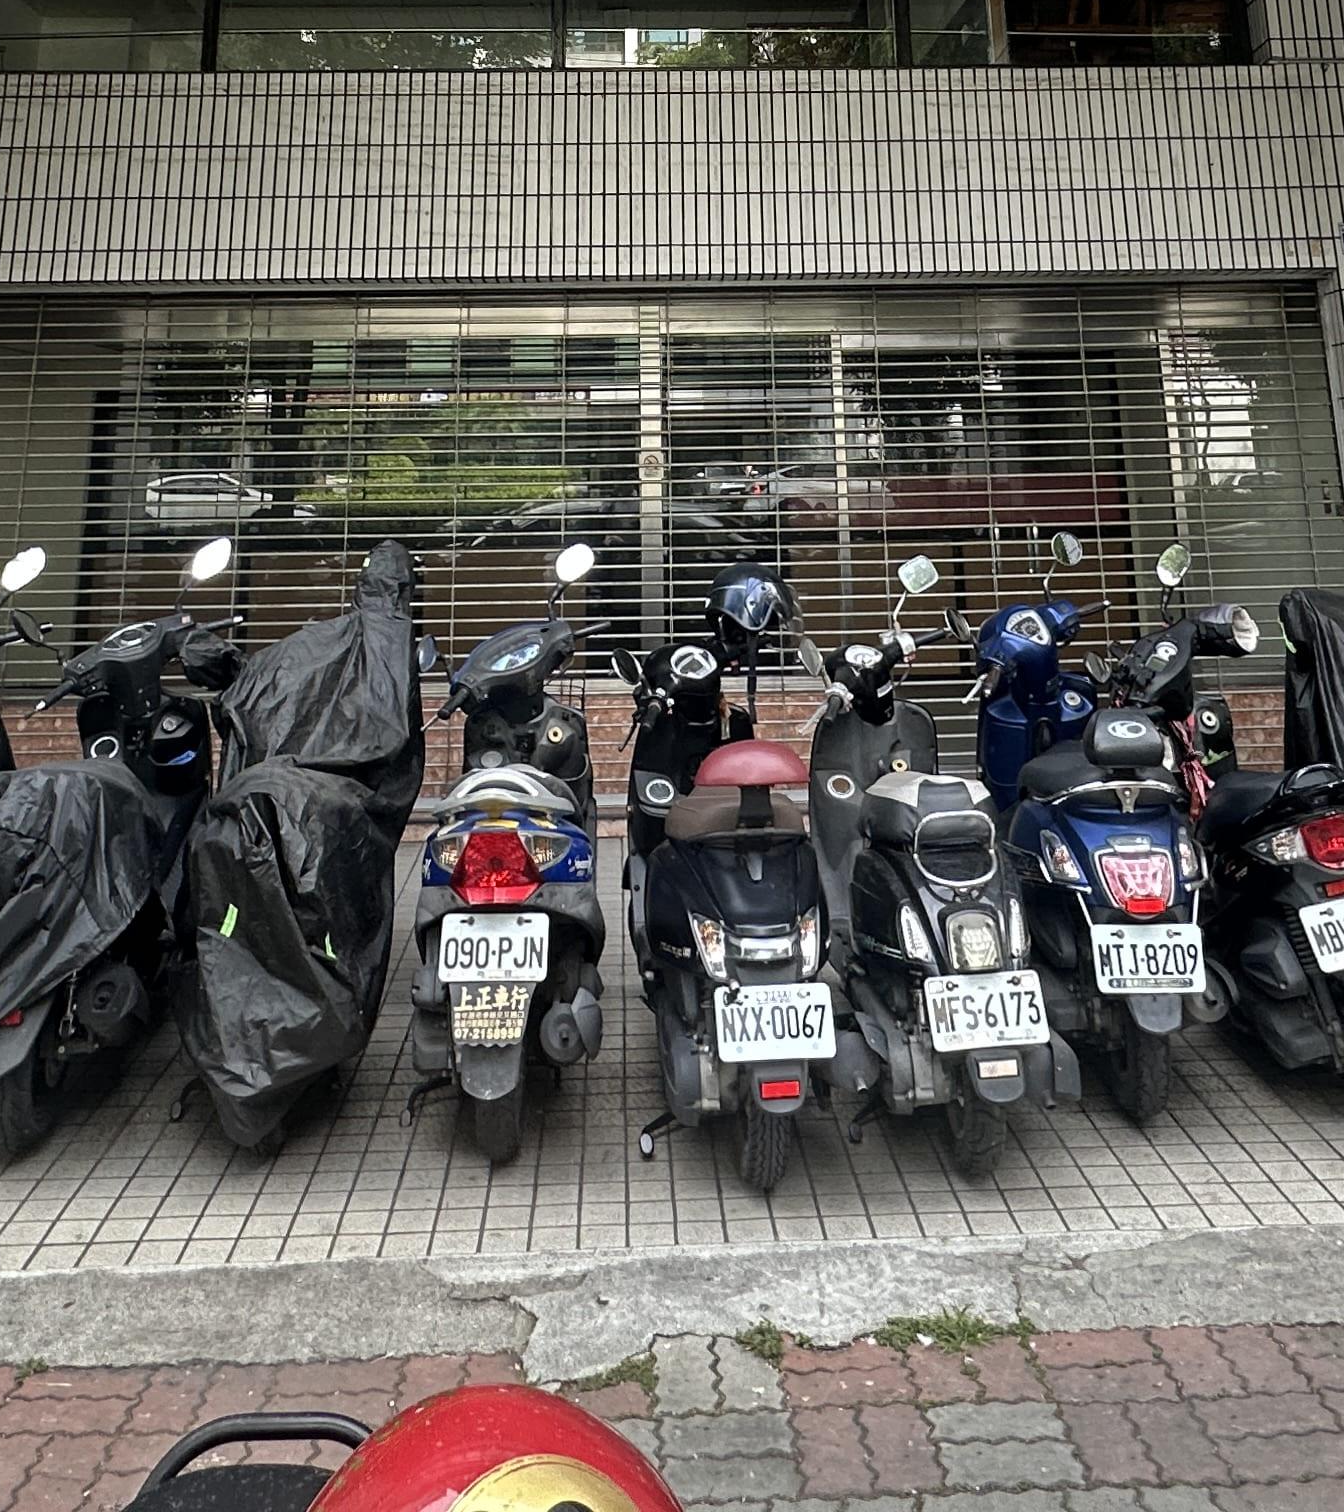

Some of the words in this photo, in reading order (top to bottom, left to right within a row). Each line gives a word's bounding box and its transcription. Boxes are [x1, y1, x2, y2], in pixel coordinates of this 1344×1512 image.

[444, 936, 544, 969] 090-PJN
[1098, 944, 1198, 976] MTJ-8209
[453, 984, 530, 1012] 上正車行
[932, 991, 1041, 1034] MFS-6173
[721, 1004, 826, 1043] NXX-0067
